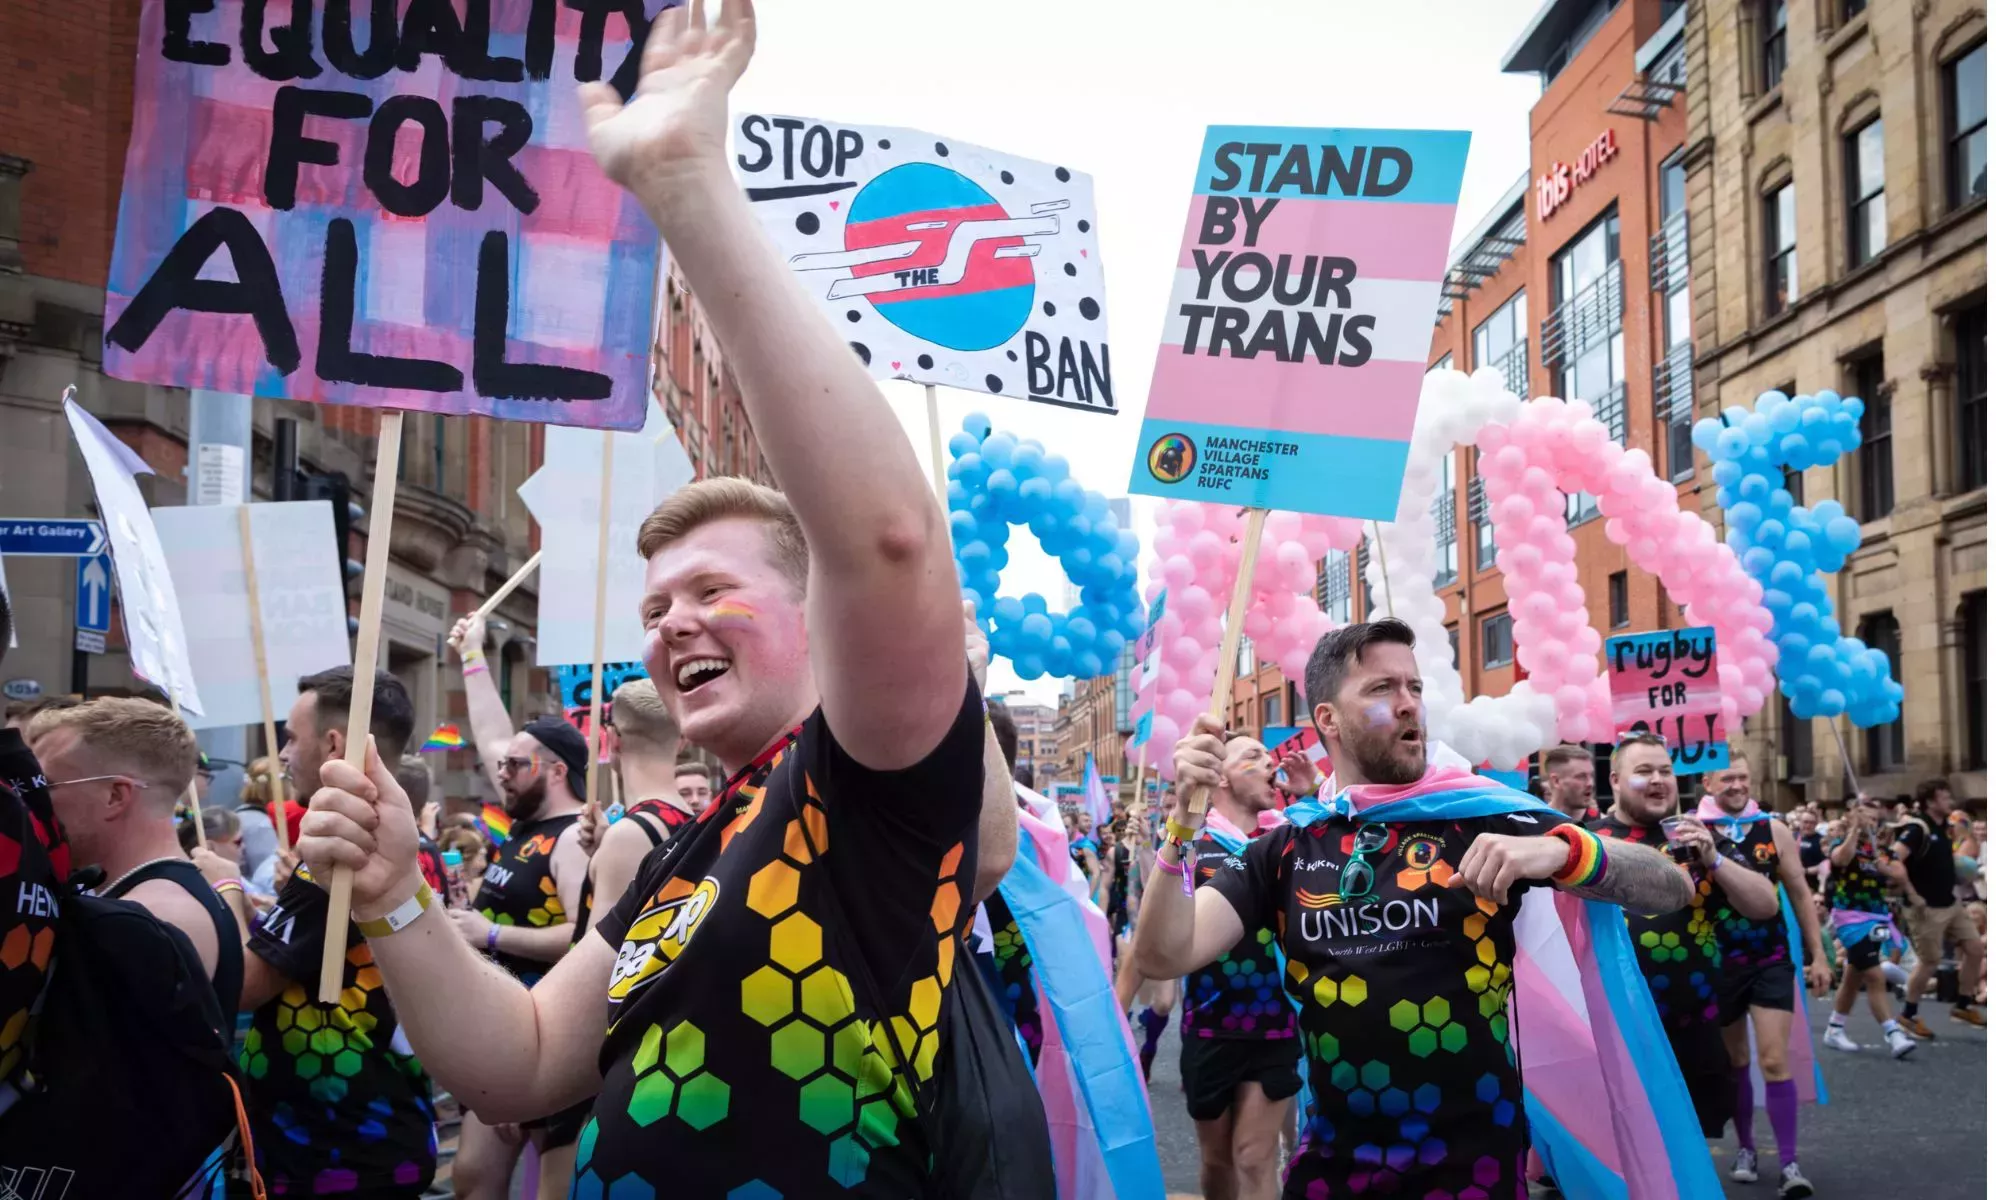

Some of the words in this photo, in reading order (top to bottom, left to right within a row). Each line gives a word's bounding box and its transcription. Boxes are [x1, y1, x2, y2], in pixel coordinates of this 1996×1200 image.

[264, 85, 540, 217] FOR
[737, 114, 864, 180] STOP
[1208, 140, 1413, 198] STAND
[1535, 160, 1573, 222] ibis
[1571, 127, 1617, 189] HOTEL
[1198, 196, 1281, 247] BY
[894, 268, 939, 287] THE
[1191, 249, 1358, 309] YOUR
[105, 206, 613, 401] ALL
[1178, 303, 1376, 368] TRANS
[1024, 331, 1115, 407] BAN
[1204, 449, 1260, 466] VILLAGE
[1206, 436, 1299, 456] MANCHESTER
[1197, 476, 1232, 490] RUFC
[1200, 463, 1269, 480] SPARTANS
[13, 525, 34, 535] Art
[38, 525, 86, 539] Gallery
[1613, 630, 1713, 679] rugby
[1648, 681, 1687, 709] FOR
[1301, 898, 1439, 942] UNISON
[1327, 946, 1353, 957] North
[1355, 944, 1377, 955] West
